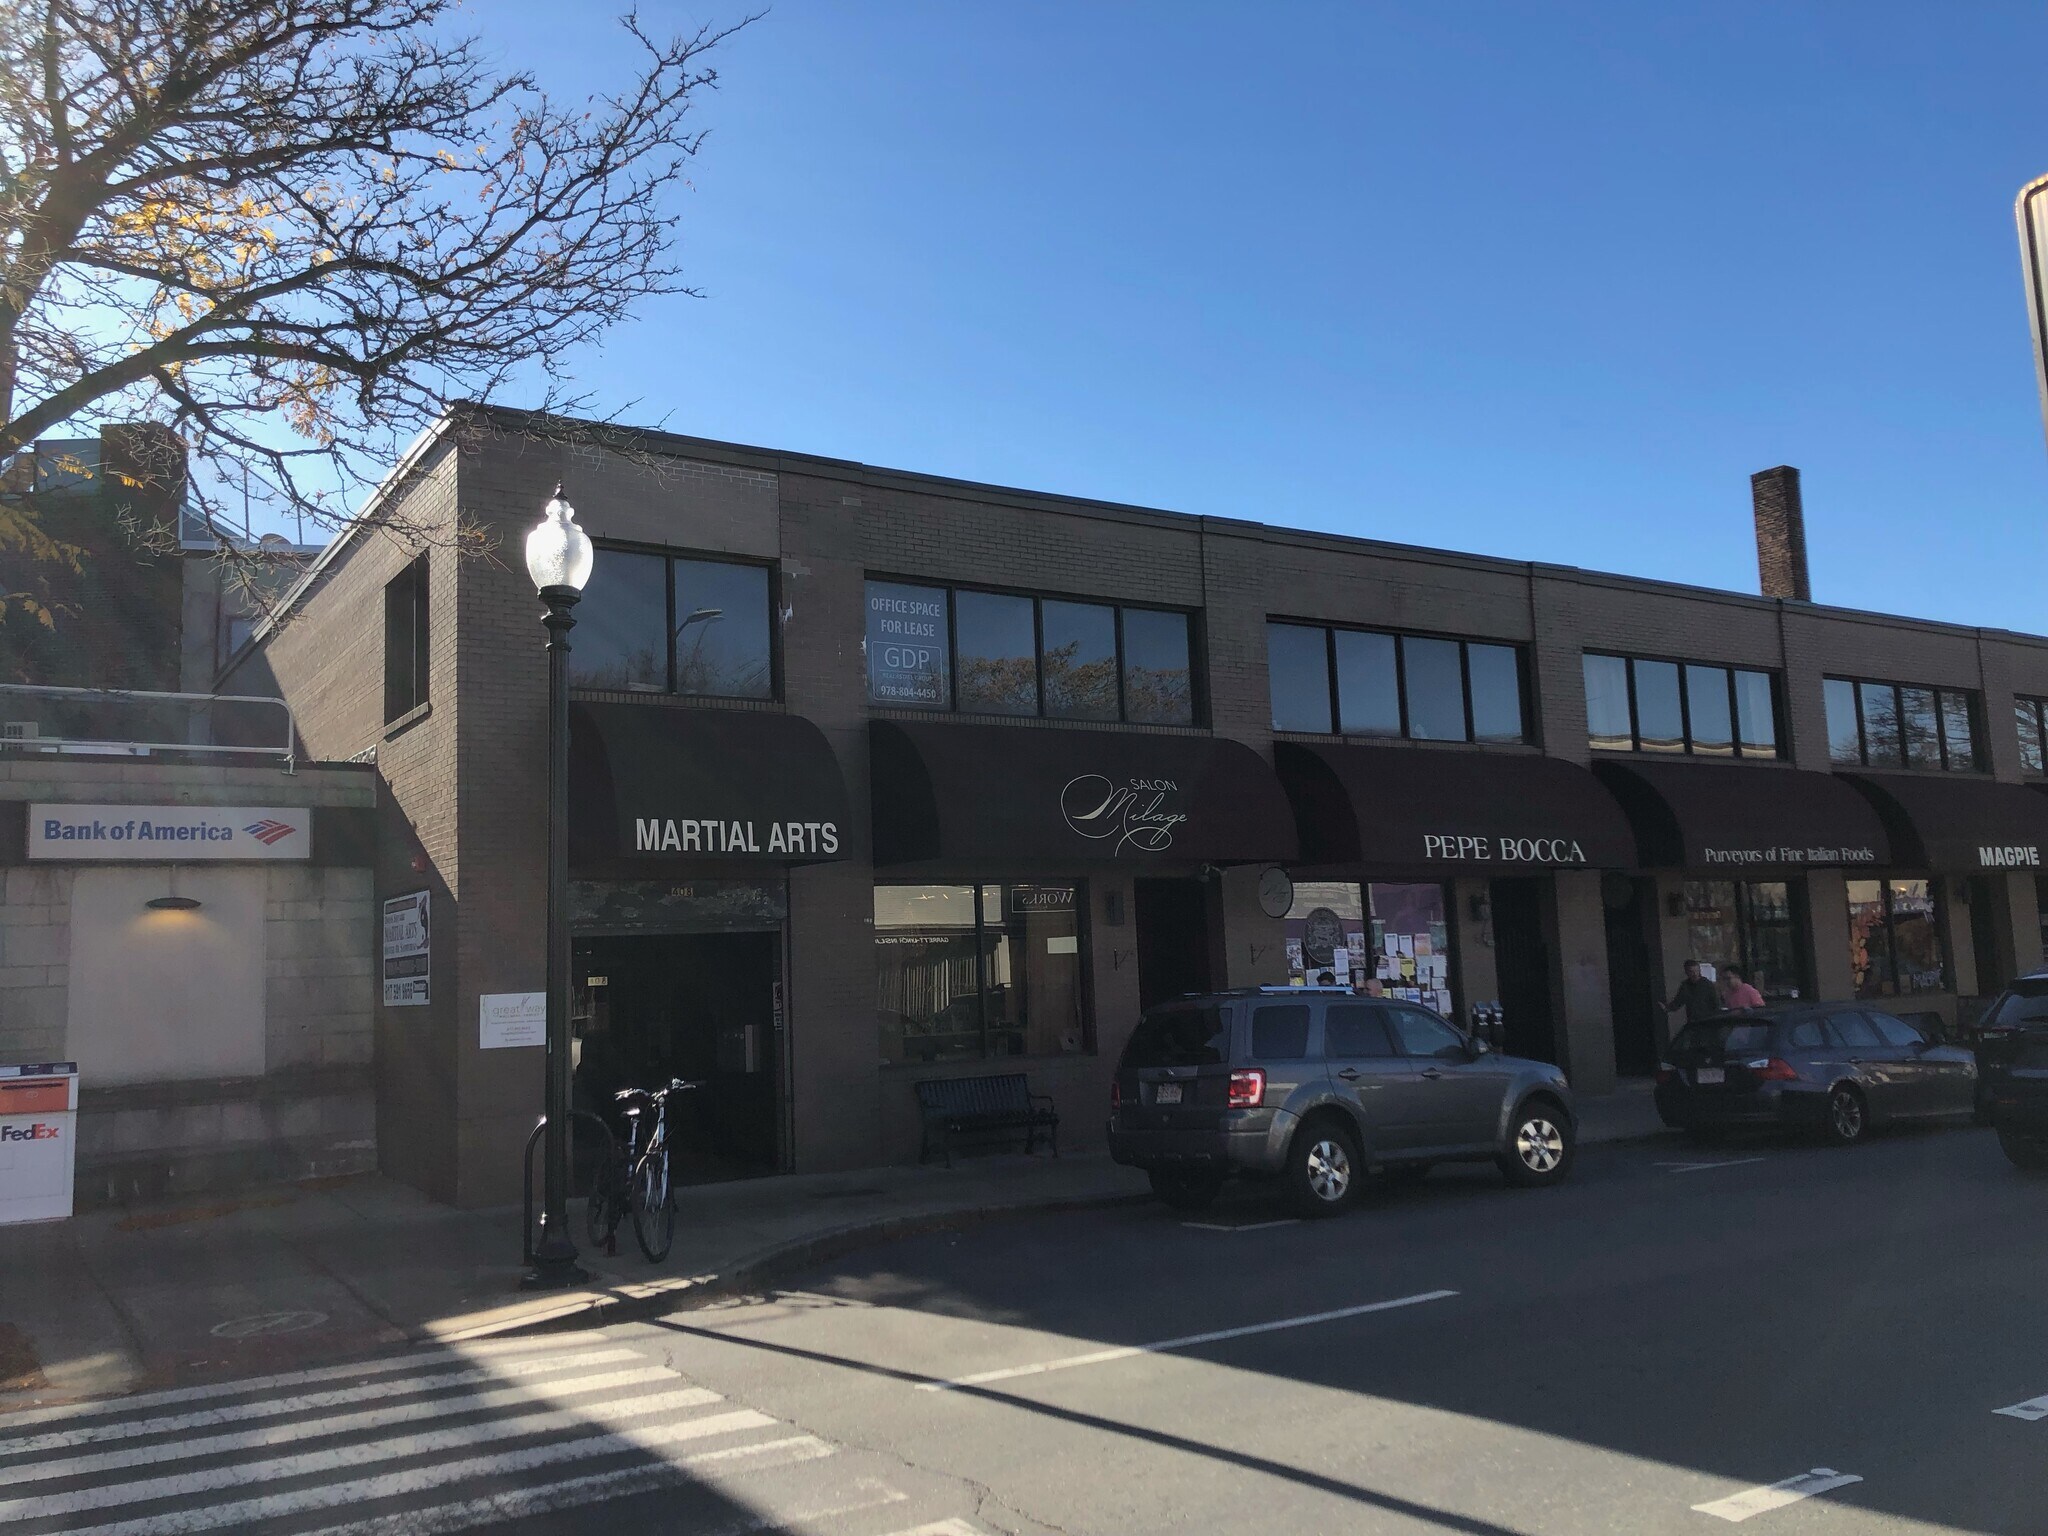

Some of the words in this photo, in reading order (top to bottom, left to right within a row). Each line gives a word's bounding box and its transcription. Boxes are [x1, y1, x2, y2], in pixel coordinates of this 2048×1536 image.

[871, 598, 907, 614] OFFICE
[909, 601, 940, 617] SPACE
[881, 619, 902, 634] FOR
[904, 621, 935, 637] LEASE
[884, 647, 930, 670] GDP
[881, 685, 937, 699] 978-804-4450
[1130, 778, 1178, 791] SALON
[44, 819, 106, 841] Bank
[110, 820, 135, 841] of
[138, 821, 233, 841] America
[636, 818, 760, 853] MARTIAL
[767, 822, 839, 854] ARTS
[1423, 835, 1491, 860] PEPE
[1499, 837, 1587, 863] BOCCA
[1705, 848, 1763, 866] Purveyors
[1765, 847, 1777, 862] of
[1780, 847, 1803, 862] Fine
[1807, 847, 1839, 861] Italian
[1841, 847, 1875, 861] Foods
[1978, 846, 2040, 866] MAGPIE
[671, 887, 694, 897] 408
[492, 1005, 520, 1015] great
[526, 1004, 546, 1014] way
[1, 1123, 60, 1142] FedEx
